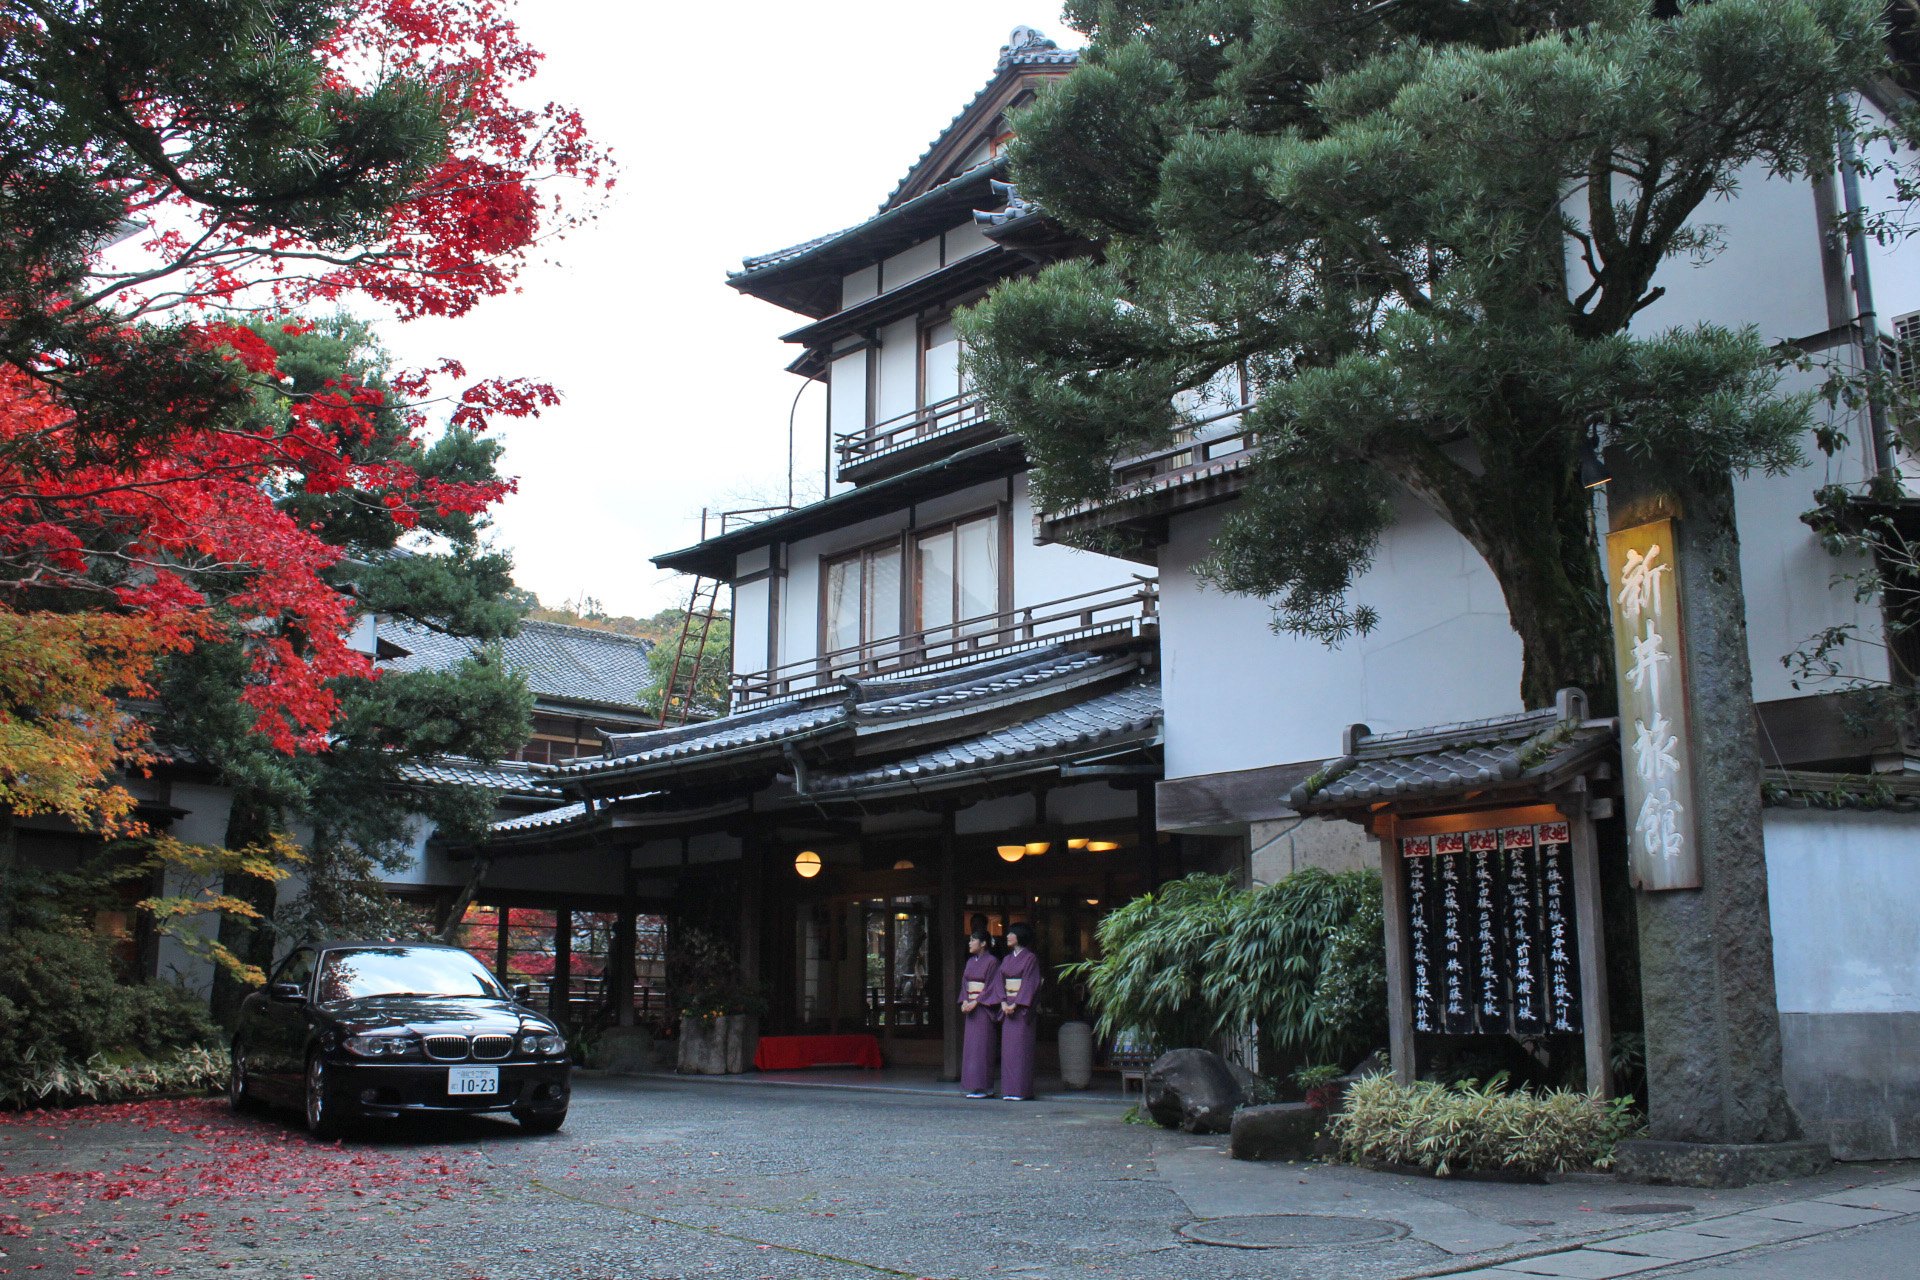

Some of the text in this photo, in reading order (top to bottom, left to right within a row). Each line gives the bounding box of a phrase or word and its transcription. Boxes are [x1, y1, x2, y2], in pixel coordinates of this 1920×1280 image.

[1616, 543, 1684, 862] 新井旅館
[461, 1079, 496, 1092] 10-23
